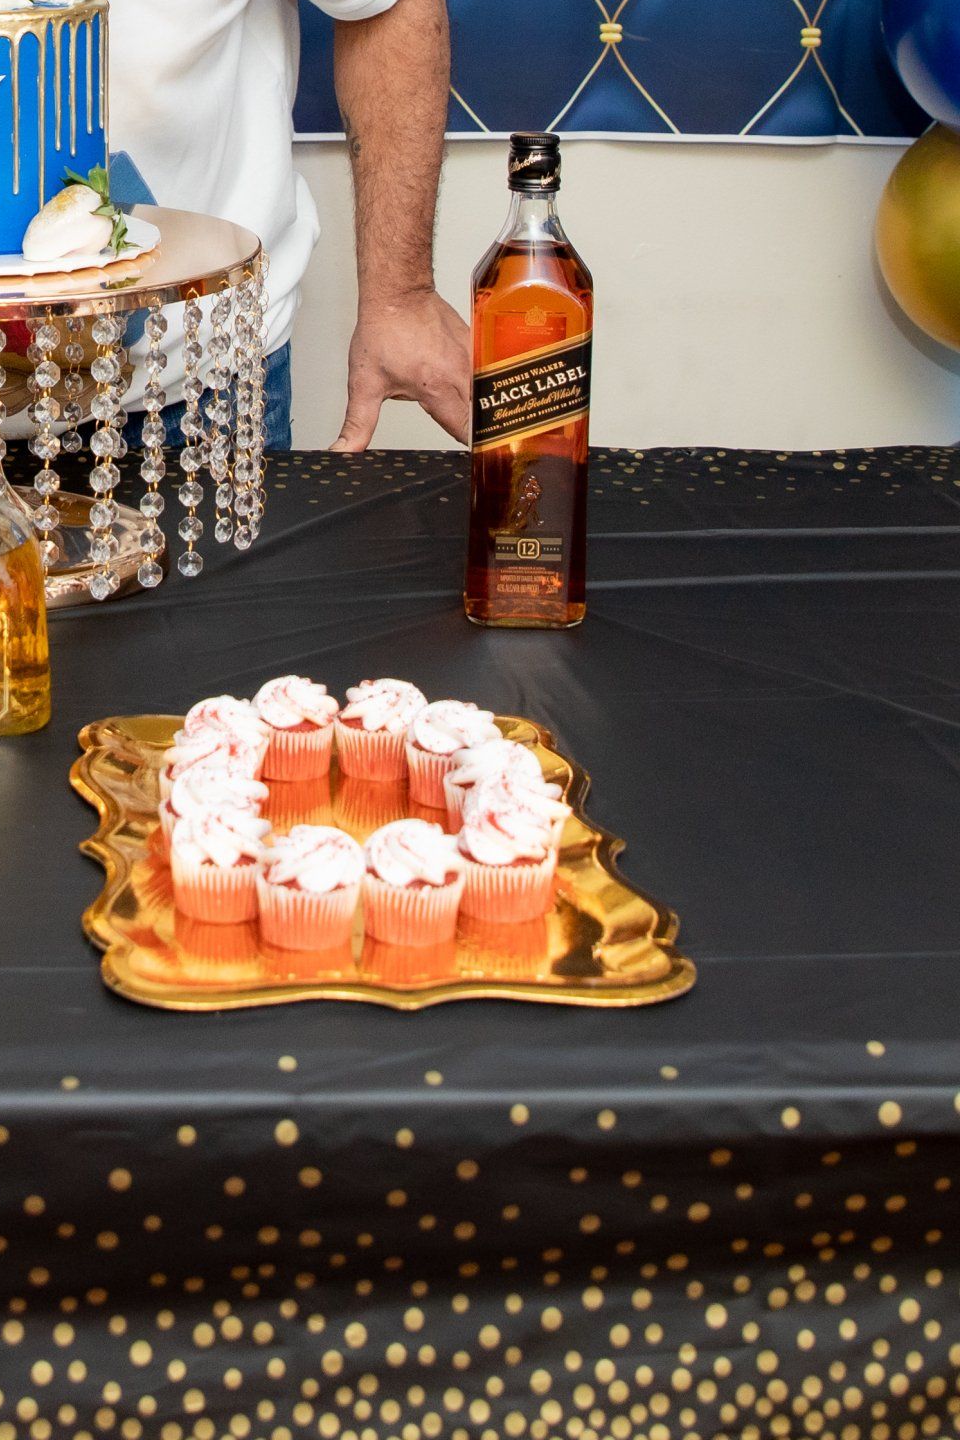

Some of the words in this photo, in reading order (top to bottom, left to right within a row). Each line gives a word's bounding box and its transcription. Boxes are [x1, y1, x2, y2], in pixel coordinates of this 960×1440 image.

[479, 383, 533, 410] BLACK
[535, 365, 587, 392] LABEL
[521, 542, 536, 556] 12
